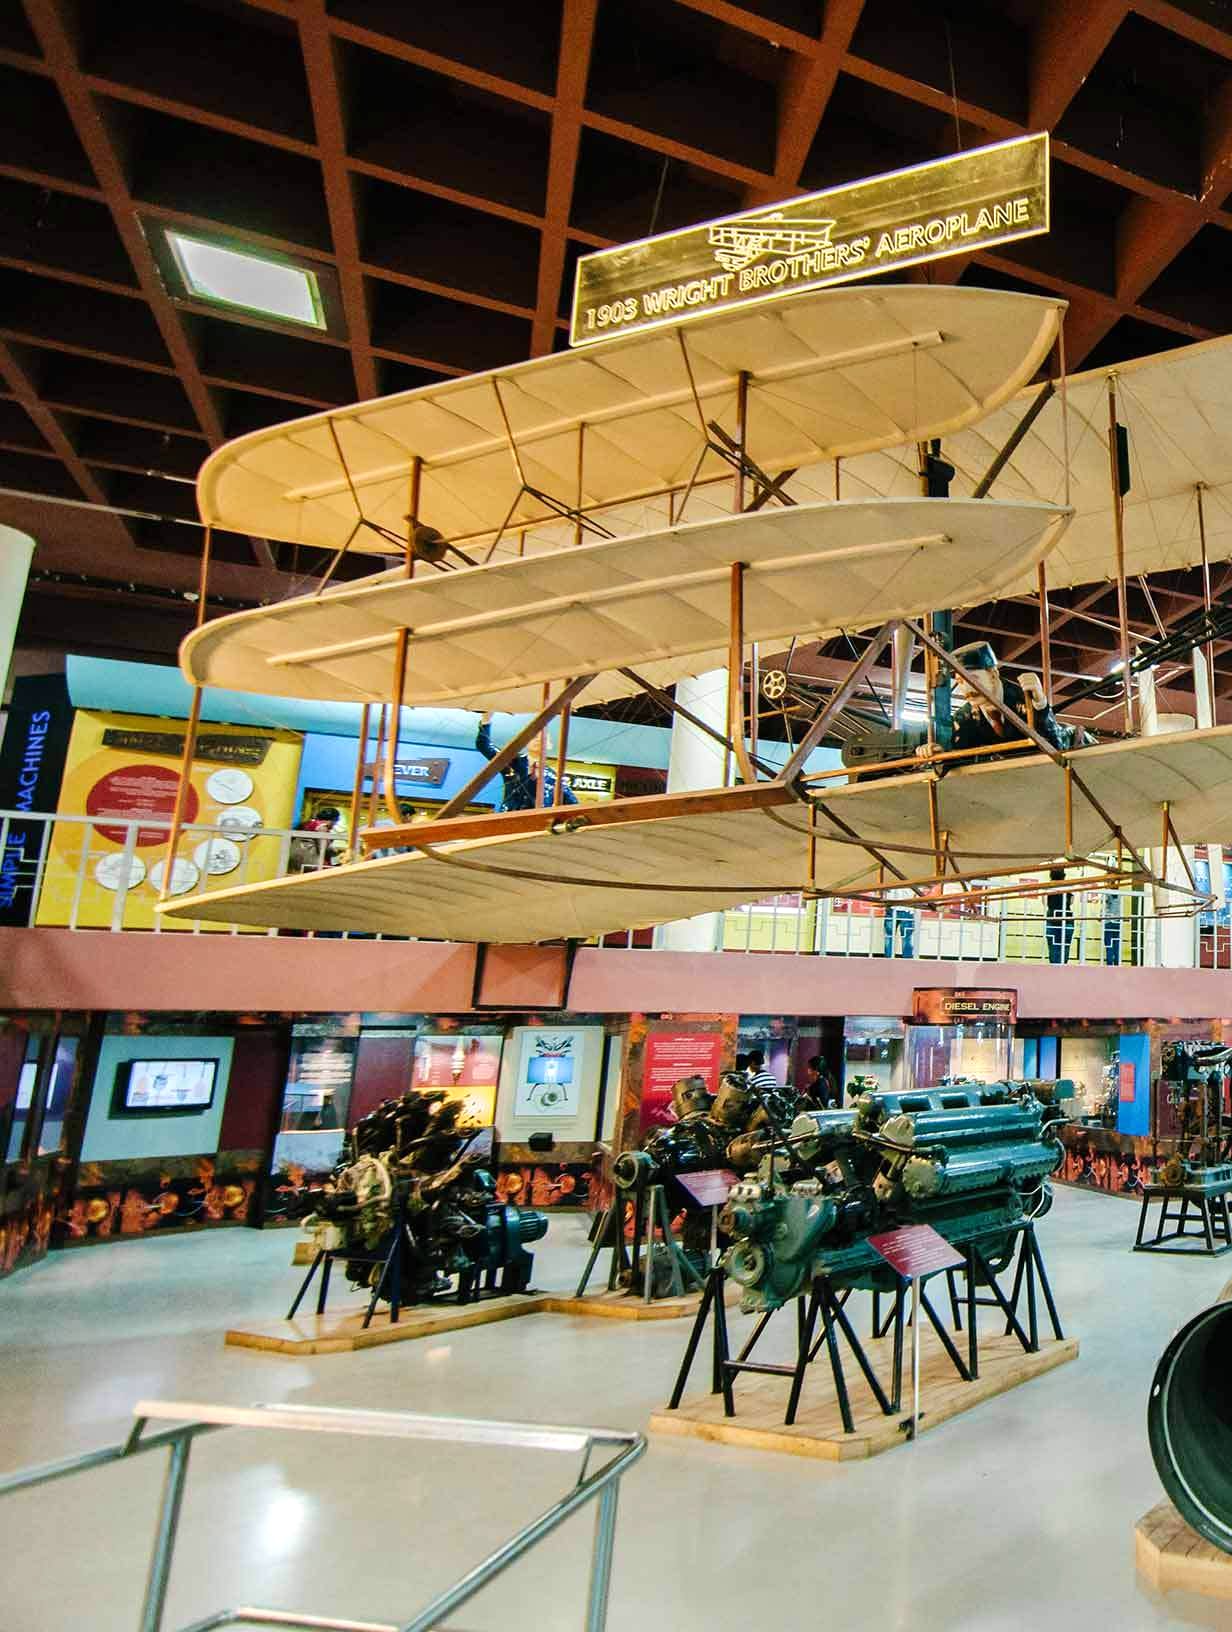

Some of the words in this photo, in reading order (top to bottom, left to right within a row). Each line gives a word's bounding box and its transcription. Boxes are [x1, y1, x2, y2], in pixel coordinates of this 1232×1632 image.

[583, 296, 639, 330] 1903
[642, 272, 735, 316] WRIGHT
[738, 236, 871, 292] BROTHERS'
[875, 198, 1030, 258] AEROPLANE
[394, 763, 430, 777] EVER
[573, 778, 607, 790] AXLE
[944, 1002, 979, 1011] DIESEL
[982, 1002, 1010, 1012] ENGINE
